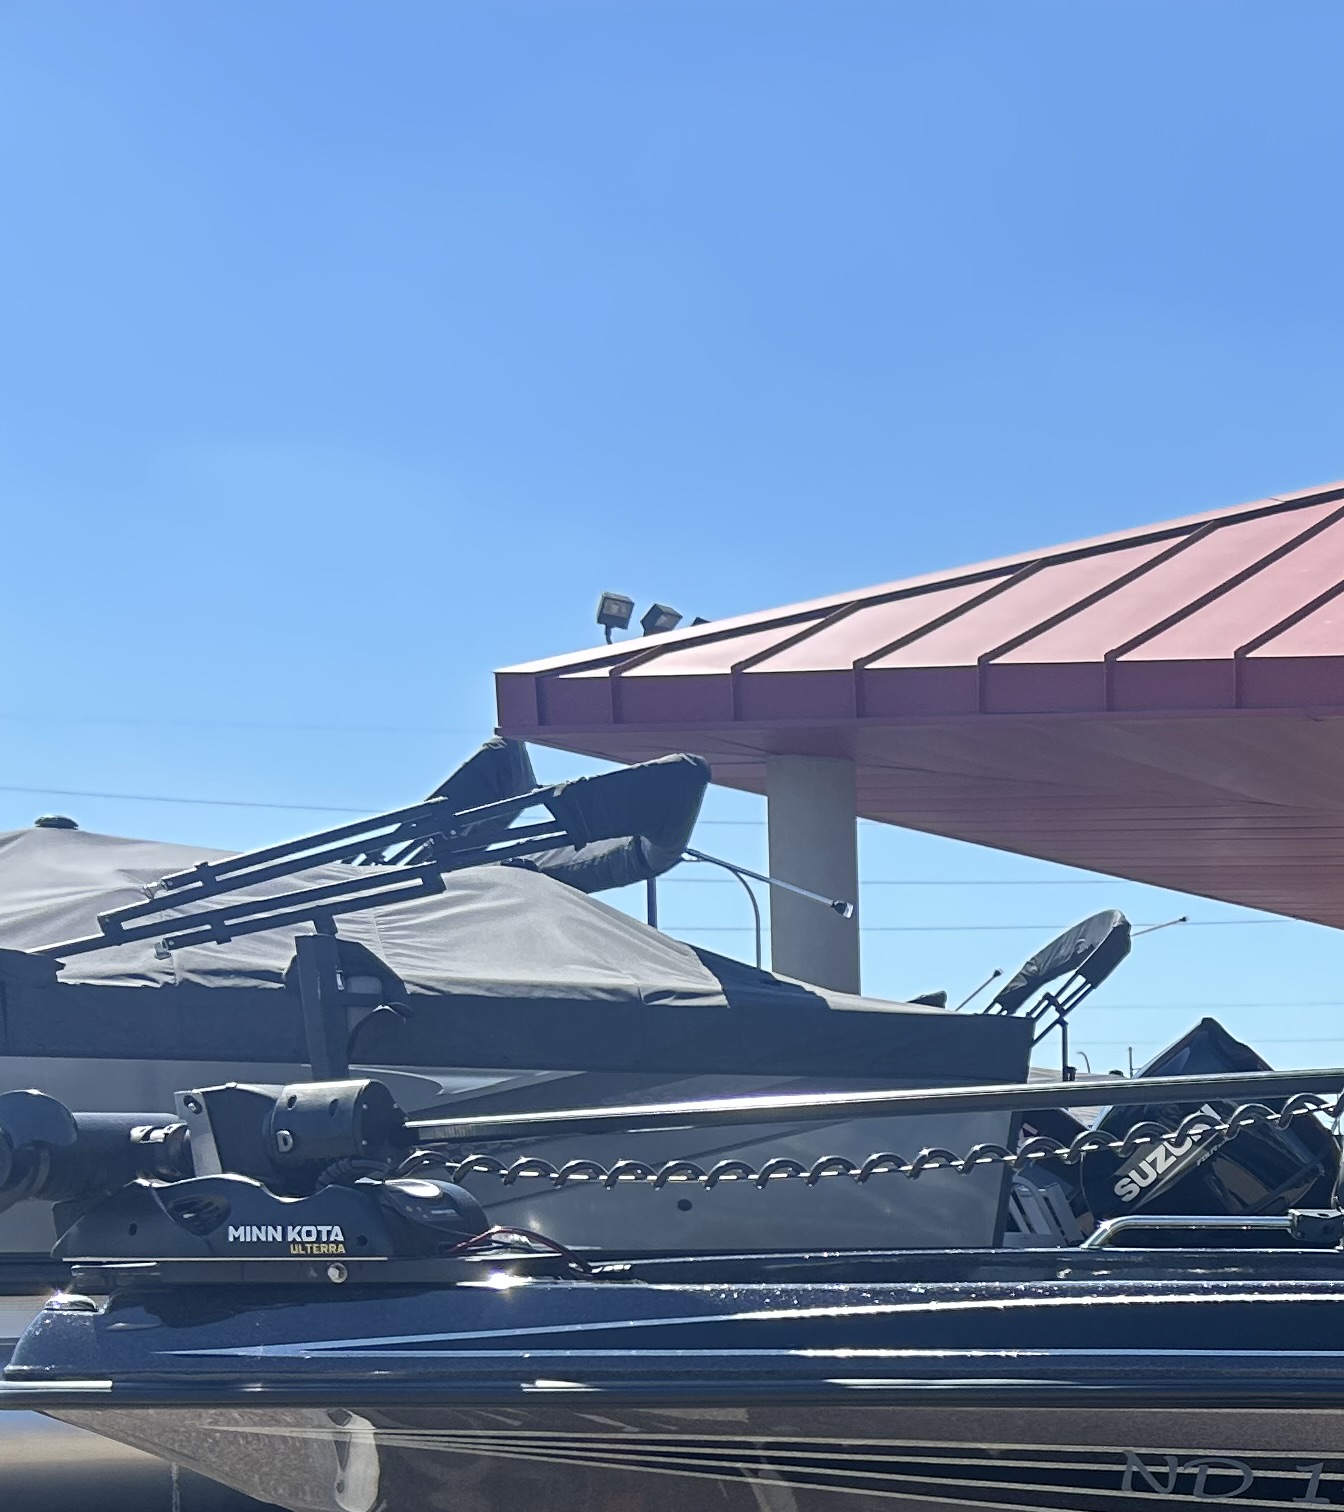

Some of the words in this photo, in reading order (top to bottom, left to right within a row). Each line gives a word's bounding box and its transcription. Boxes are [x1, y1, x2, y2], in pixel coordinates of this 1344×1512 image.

[228, 1225, 282, 1242] MINN
[287, 1225, 345, 1242] KOTA
[289, 1243, 346, 1255] ULTERRA
[1121, 1450, 1254, 1499] ND
